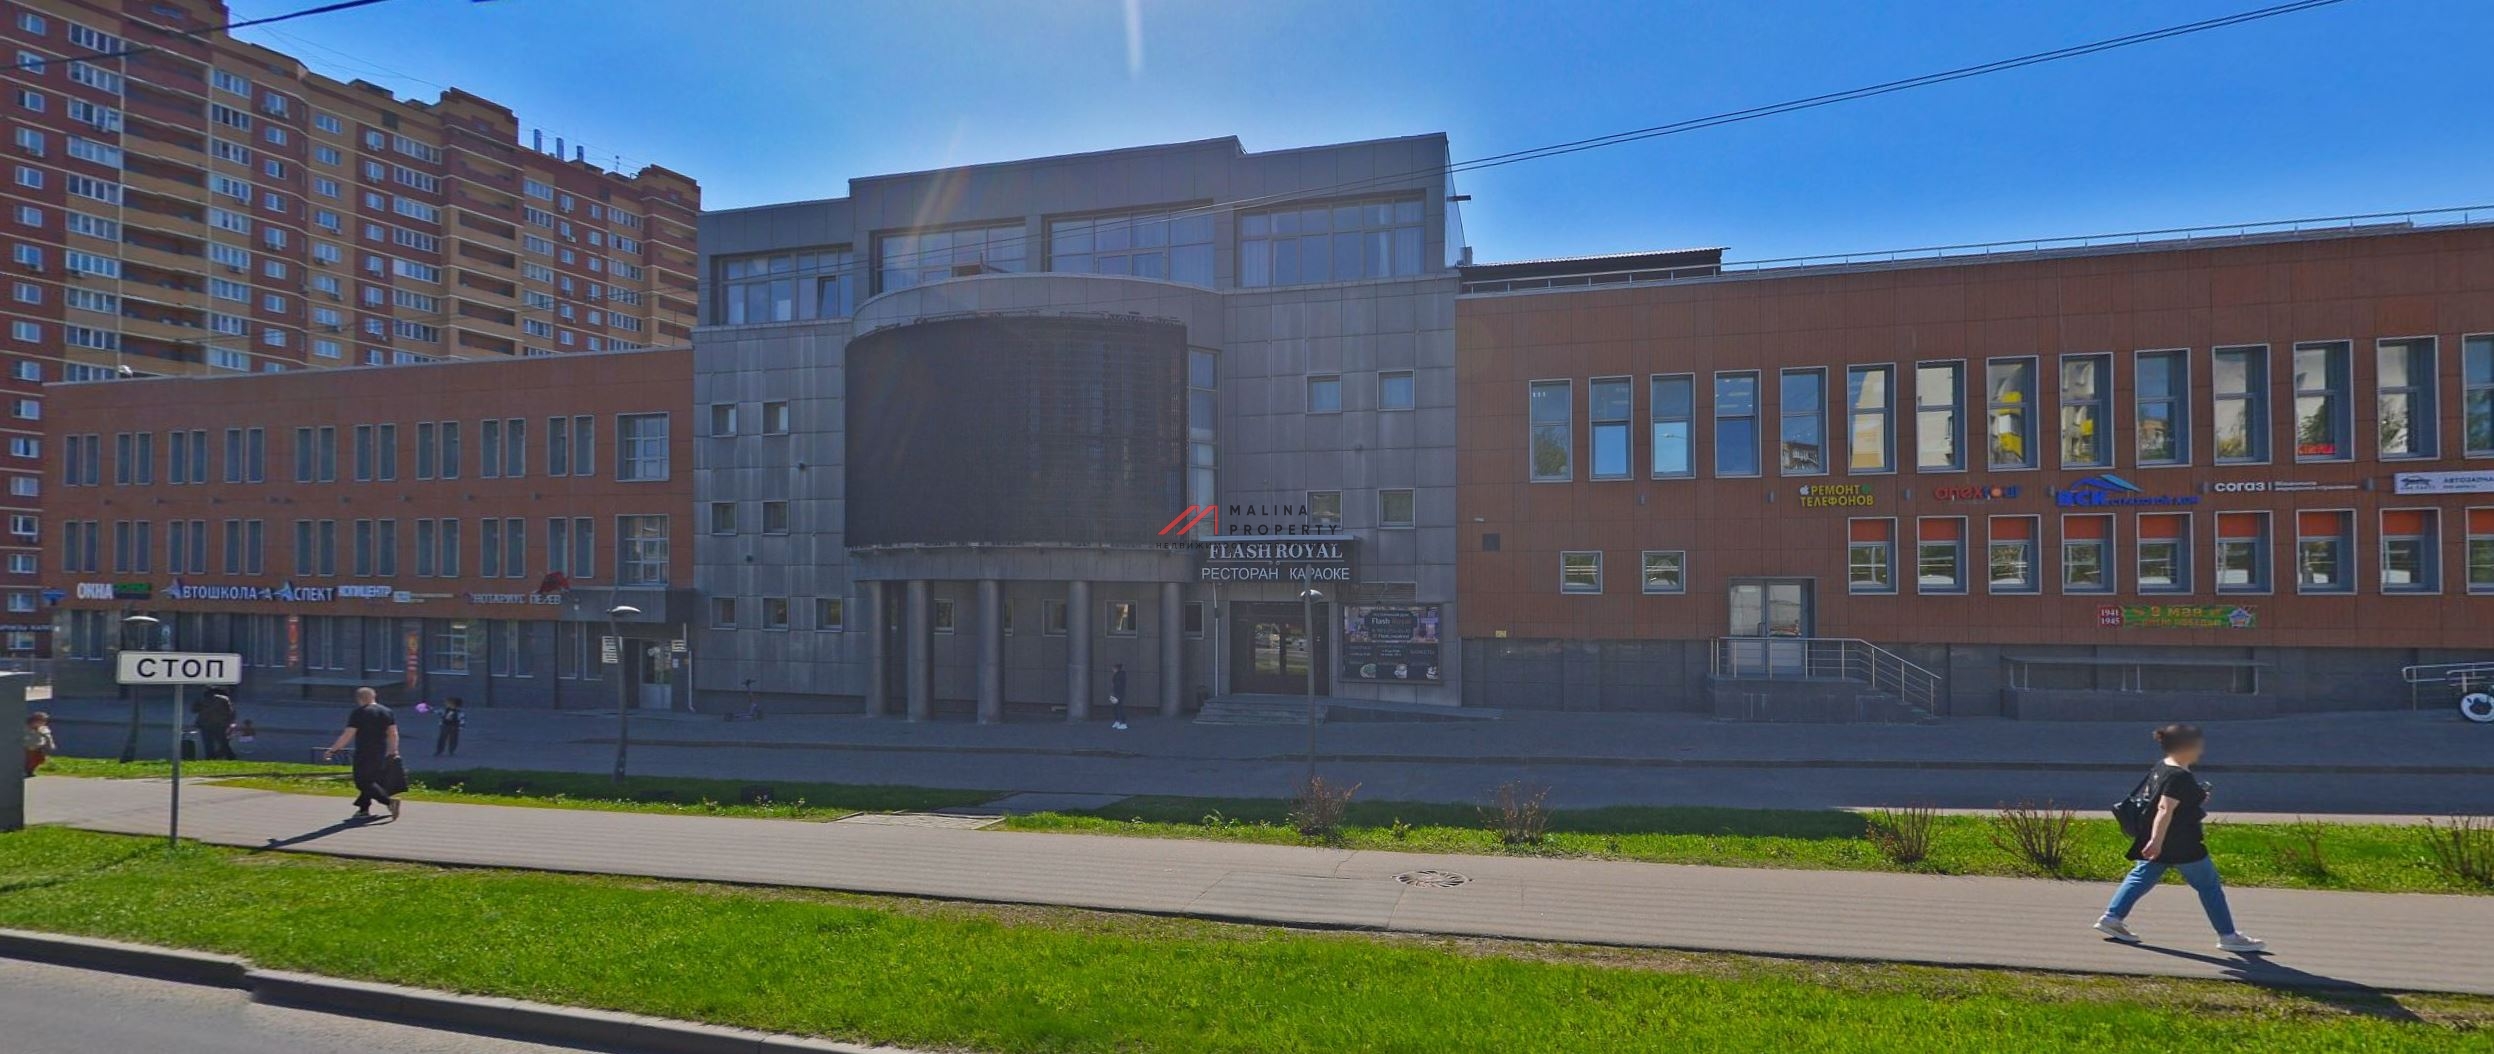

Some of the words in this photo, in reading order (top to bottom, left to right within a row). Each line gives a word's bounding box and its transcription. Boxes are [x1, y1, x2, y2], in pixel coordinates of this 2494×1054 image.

[1811, 484, 1860, 496] РЕМОНТ
[1800, 495, 1874, 507] ТЕЛЕФОНОВ
[1209, 543, 1272, 559] FLASH
[1275, 543, 1343, 559] ROYAL
[1201, 567, 1279, 580] РЕСТОРАН
[1289, 567, 1350, 580] КАРАОКЕ
[2101, 608, 2119, 616] 1941
[2101, 617, 2120, 626] 1945
[137, 658, 225, 678] СТОП
